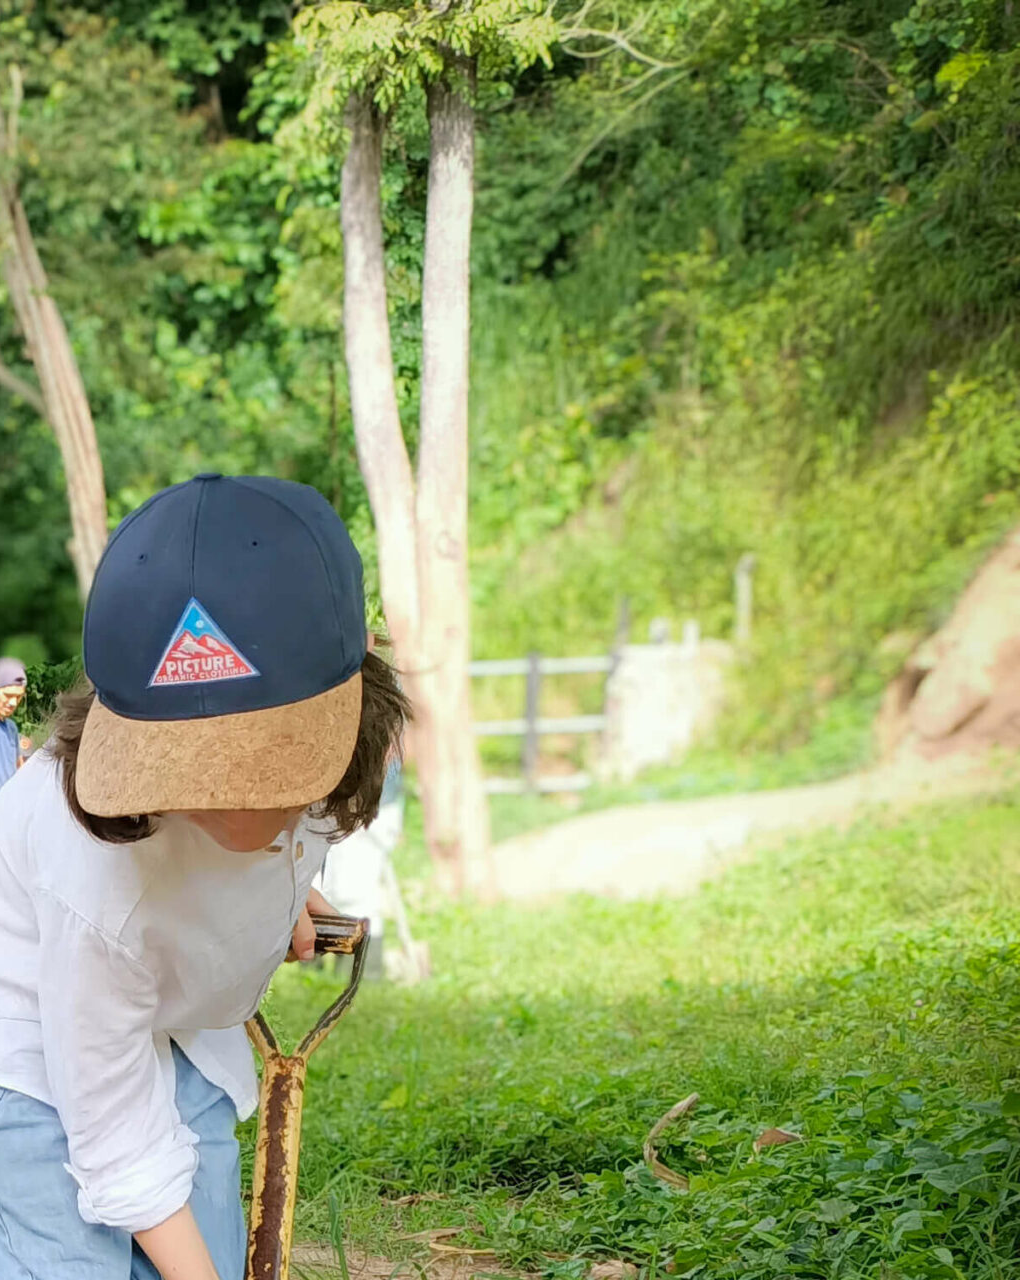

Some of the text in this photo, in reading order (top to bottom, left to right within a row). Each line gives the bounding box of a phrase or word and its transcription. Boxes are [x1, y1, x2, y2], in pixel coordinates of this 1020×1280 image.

[165, 654, 235, 675] PICTURE
[157, 666, 246, 682] ORGANIC CLOTHING
